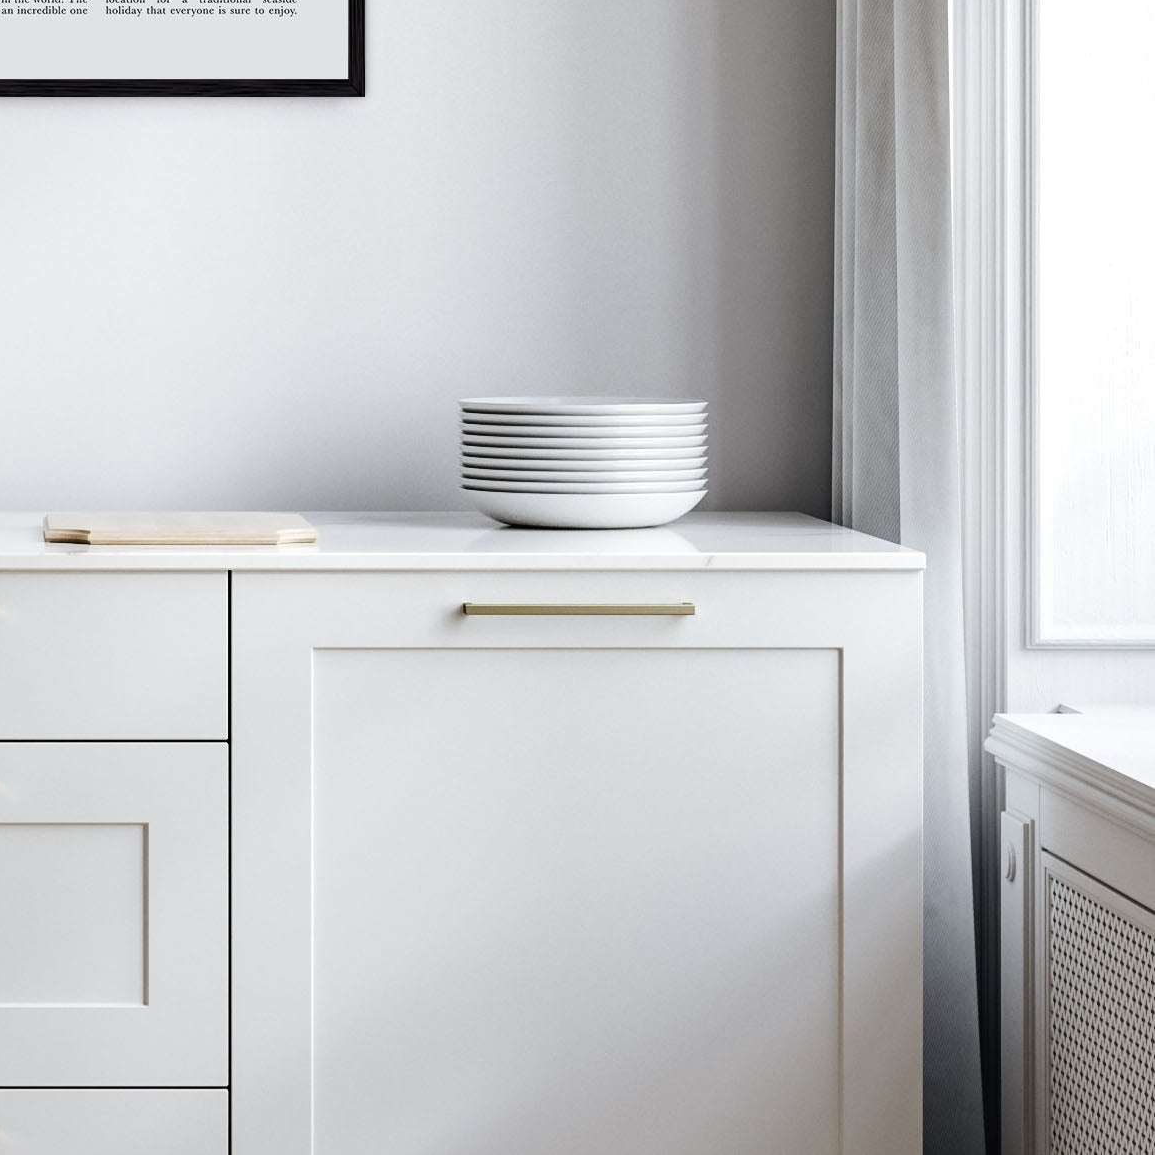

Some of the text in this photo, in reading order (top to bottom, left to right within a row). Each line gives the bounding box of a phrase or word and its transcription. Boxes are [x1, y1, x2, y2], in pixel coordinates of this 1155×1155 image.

[17, 6, 67, 14] incredible
[105, 6, 143, 17] holiday
[146, 6, 166, 14] that
[170, 8, 215, 17] everyone
[218, 6, 227, 14] is
[268, 6, 297, 17] enjoy.
